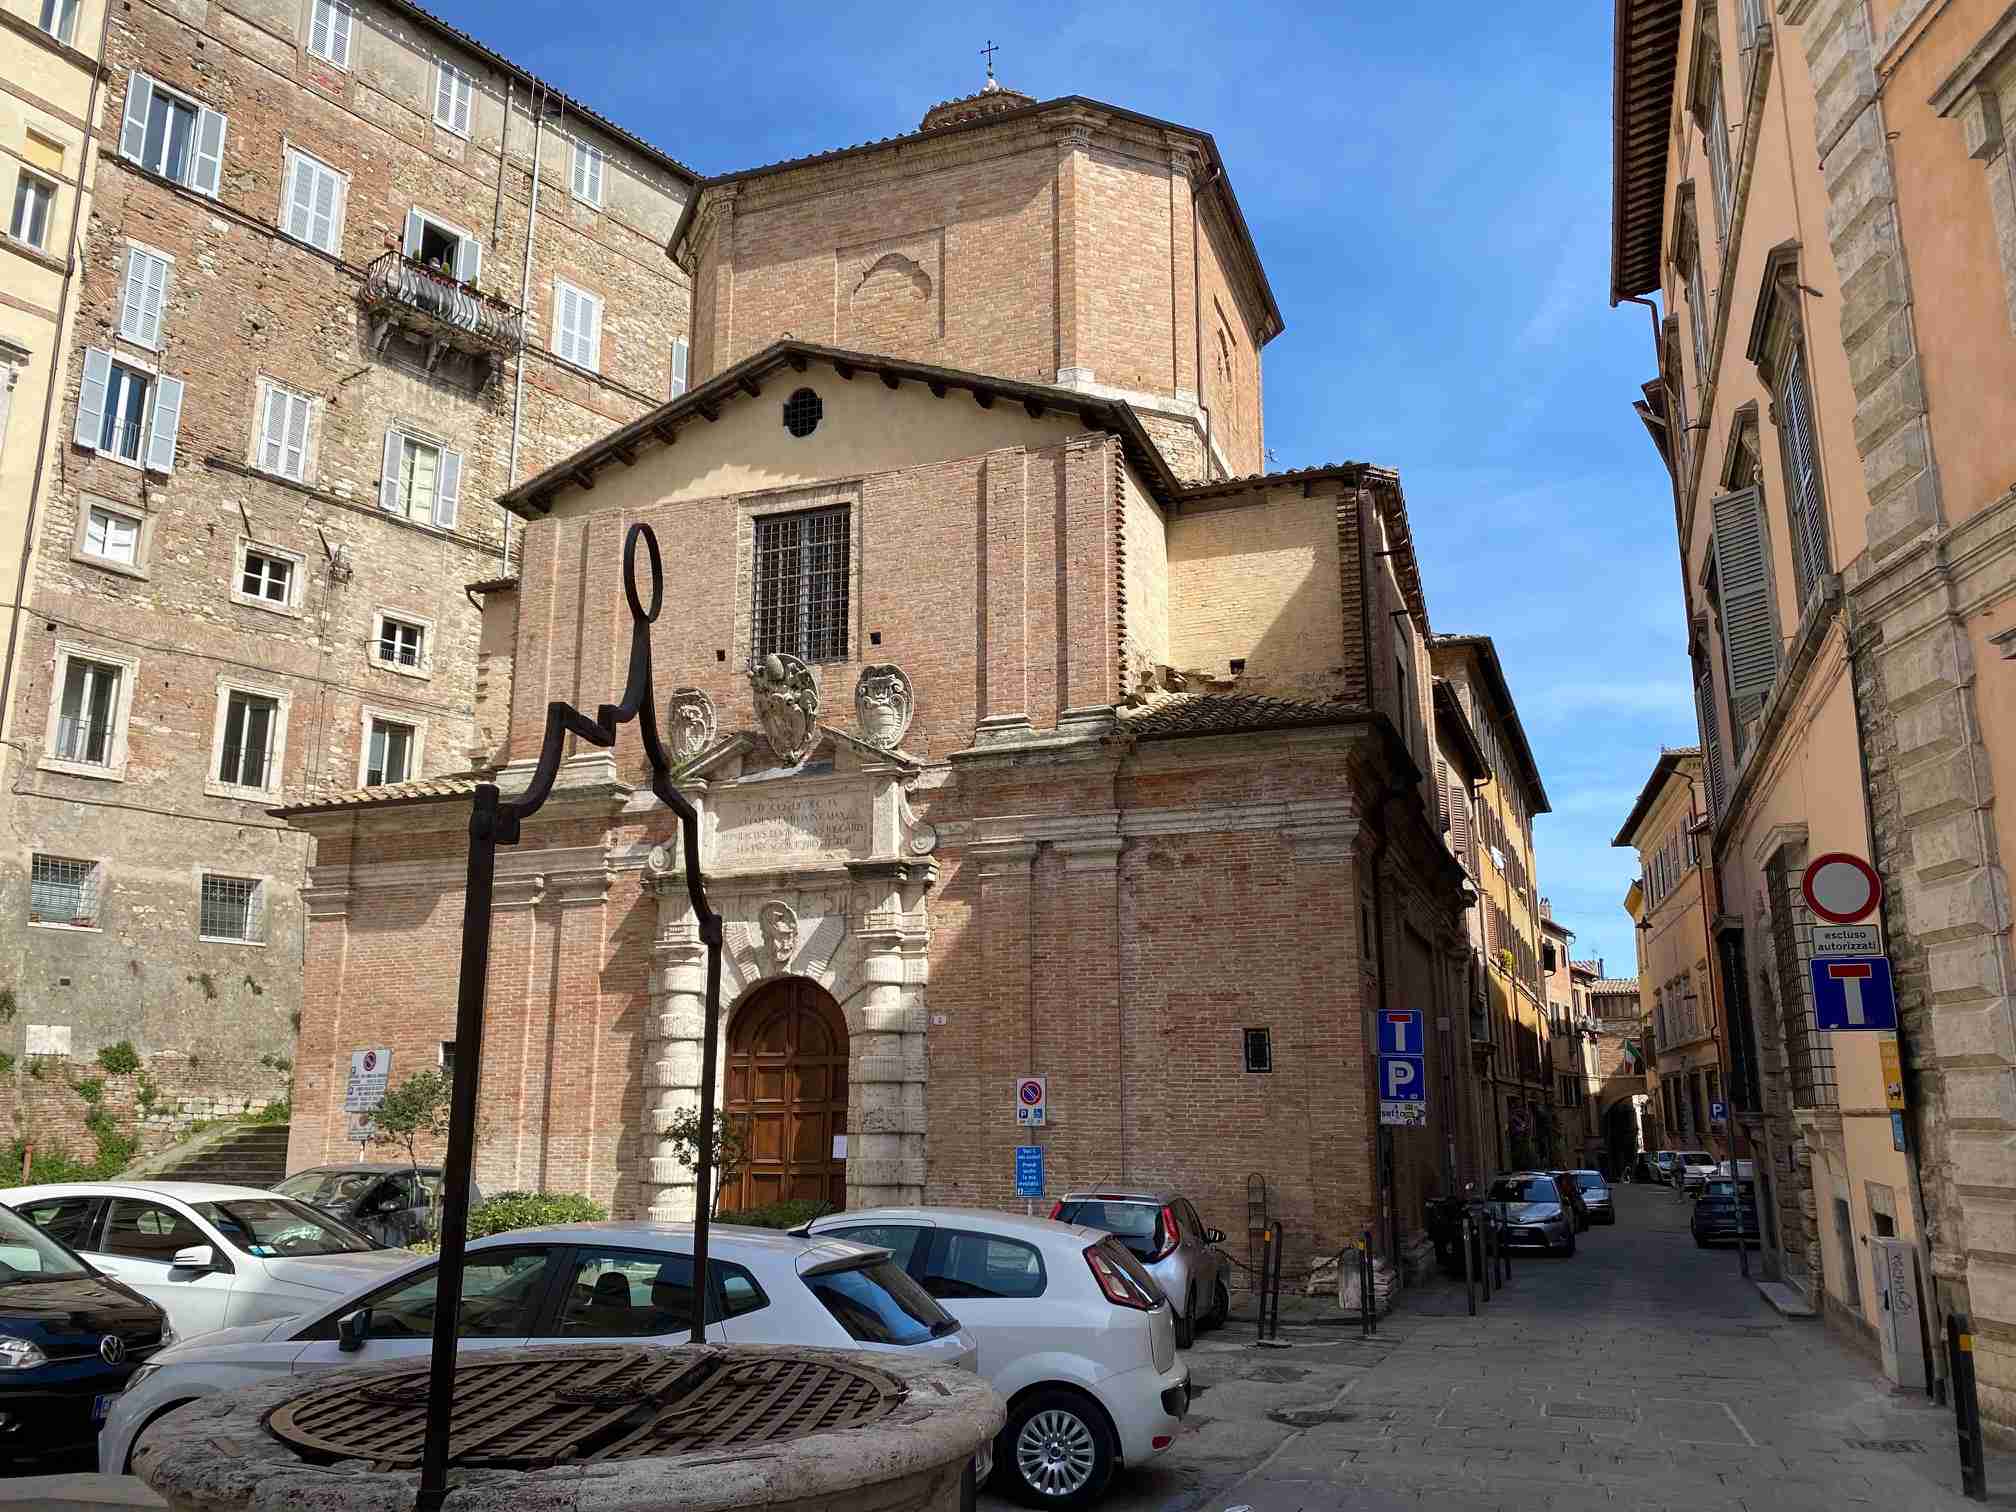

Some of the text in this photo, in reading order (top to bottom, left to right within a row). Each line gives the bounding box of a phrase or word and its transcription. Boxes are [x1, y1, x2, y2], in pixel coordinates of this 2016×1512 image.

[1824, 930, 1866, 940] escluso
[1817, 941, 1876, 952] autorizzati
[1388, 1060, 1415, 1097] P
[1712, 1103, 1723, 1116] P
